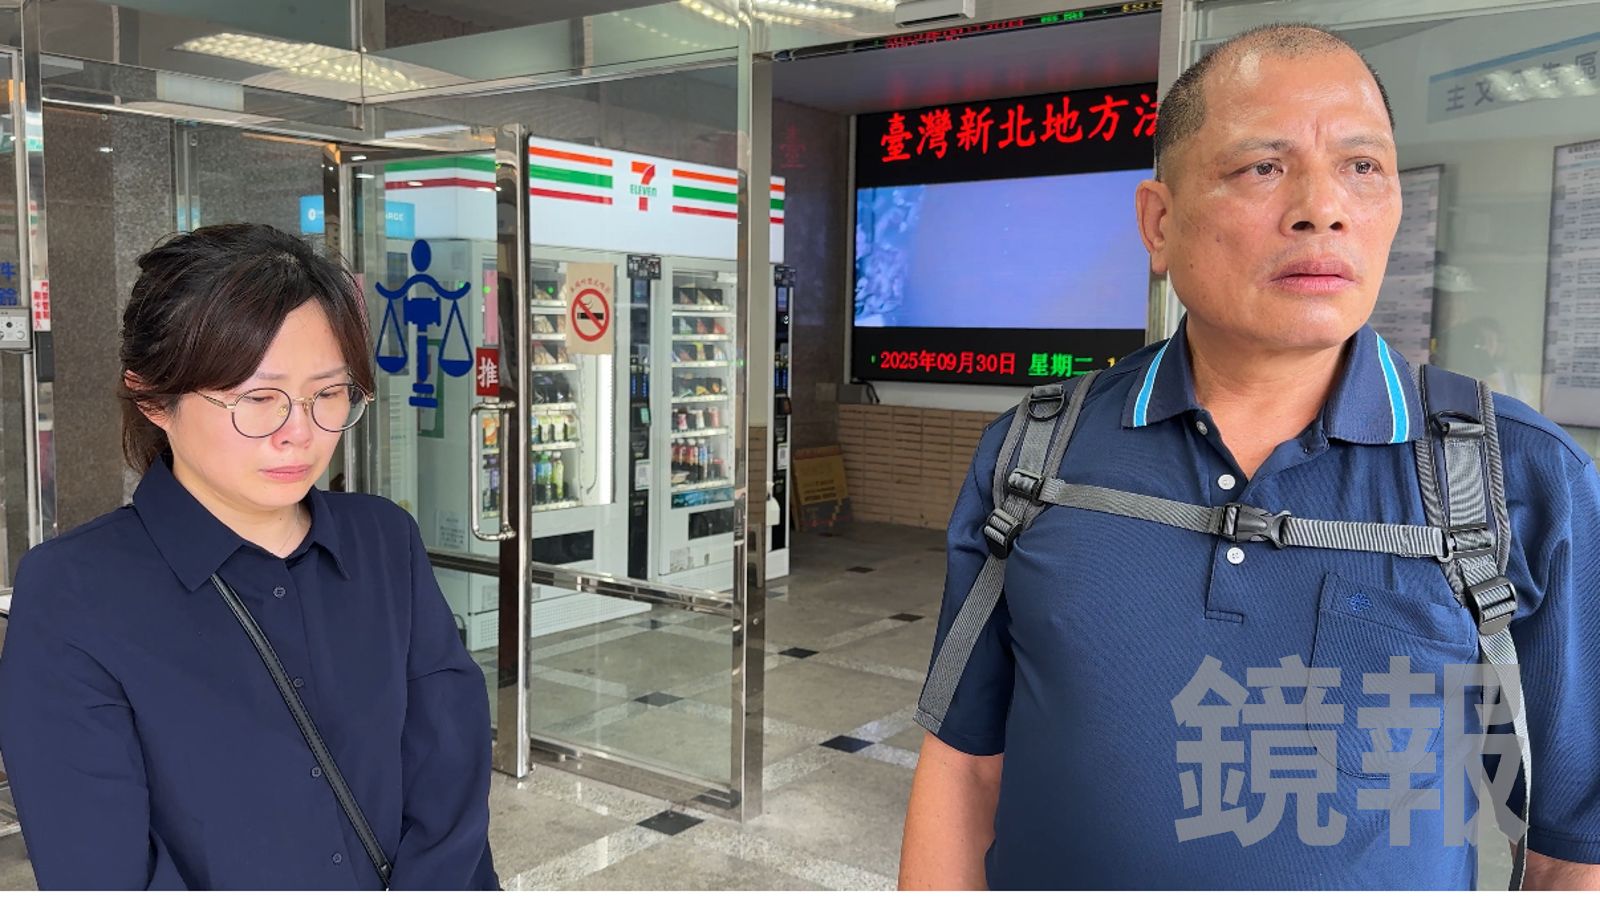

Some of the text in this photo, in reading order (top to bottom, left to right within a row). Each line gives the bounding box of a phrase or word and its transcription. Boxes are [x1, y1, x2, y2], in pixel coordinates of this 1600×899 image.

[631, 161, 656, 211] 7
[477, 356, 499, 388] 推
[880, 350, 1016, 375] 2025年09月30日
[1028, 353, 1094, 377] 星期二
